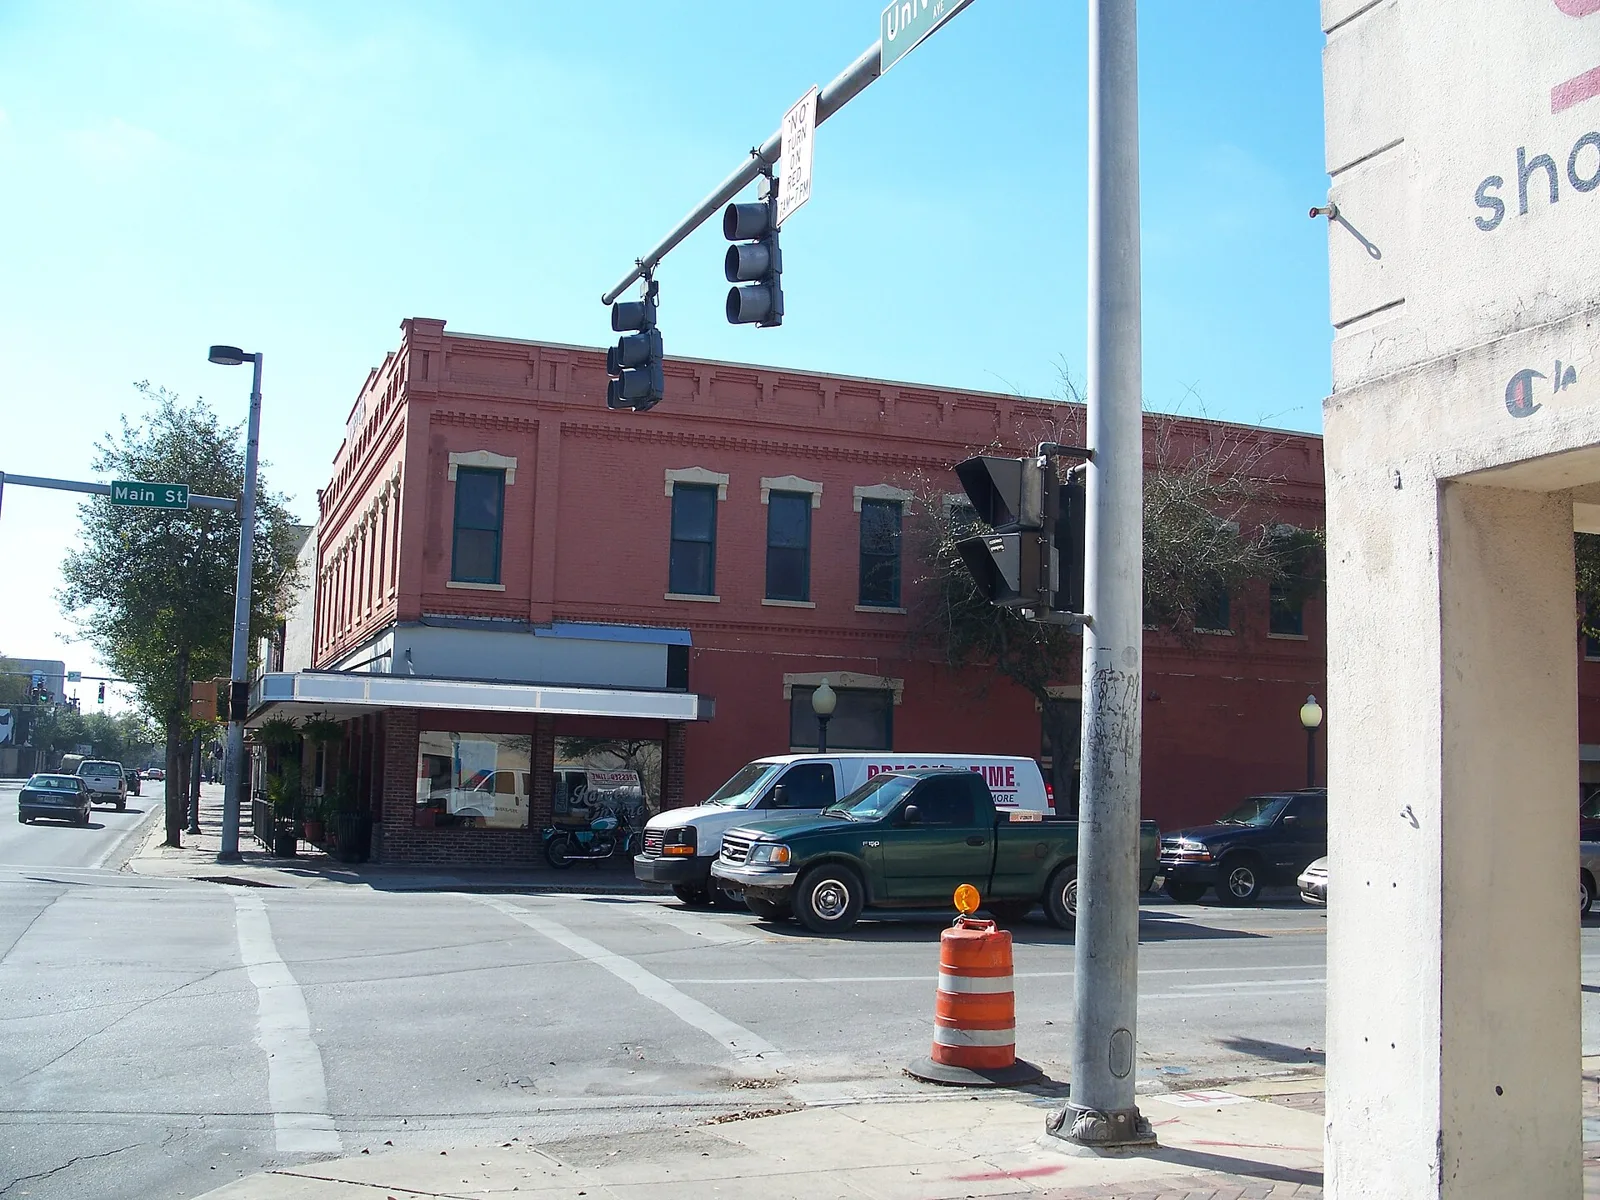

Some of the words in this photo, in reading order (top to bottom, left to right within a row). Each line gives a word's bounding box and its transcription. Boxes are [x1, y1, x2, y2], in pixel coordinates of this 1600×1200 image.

[789, 103, 807, 133] NO
[787, 124, 807, 154] TURN
[789, 148, 802, 170] ON
[786, 167, 802, 192] RED
[114, 486, 155, 502] Main
[165, 490, 187, 503] St.
[970, 765, 1015, 787] IME
